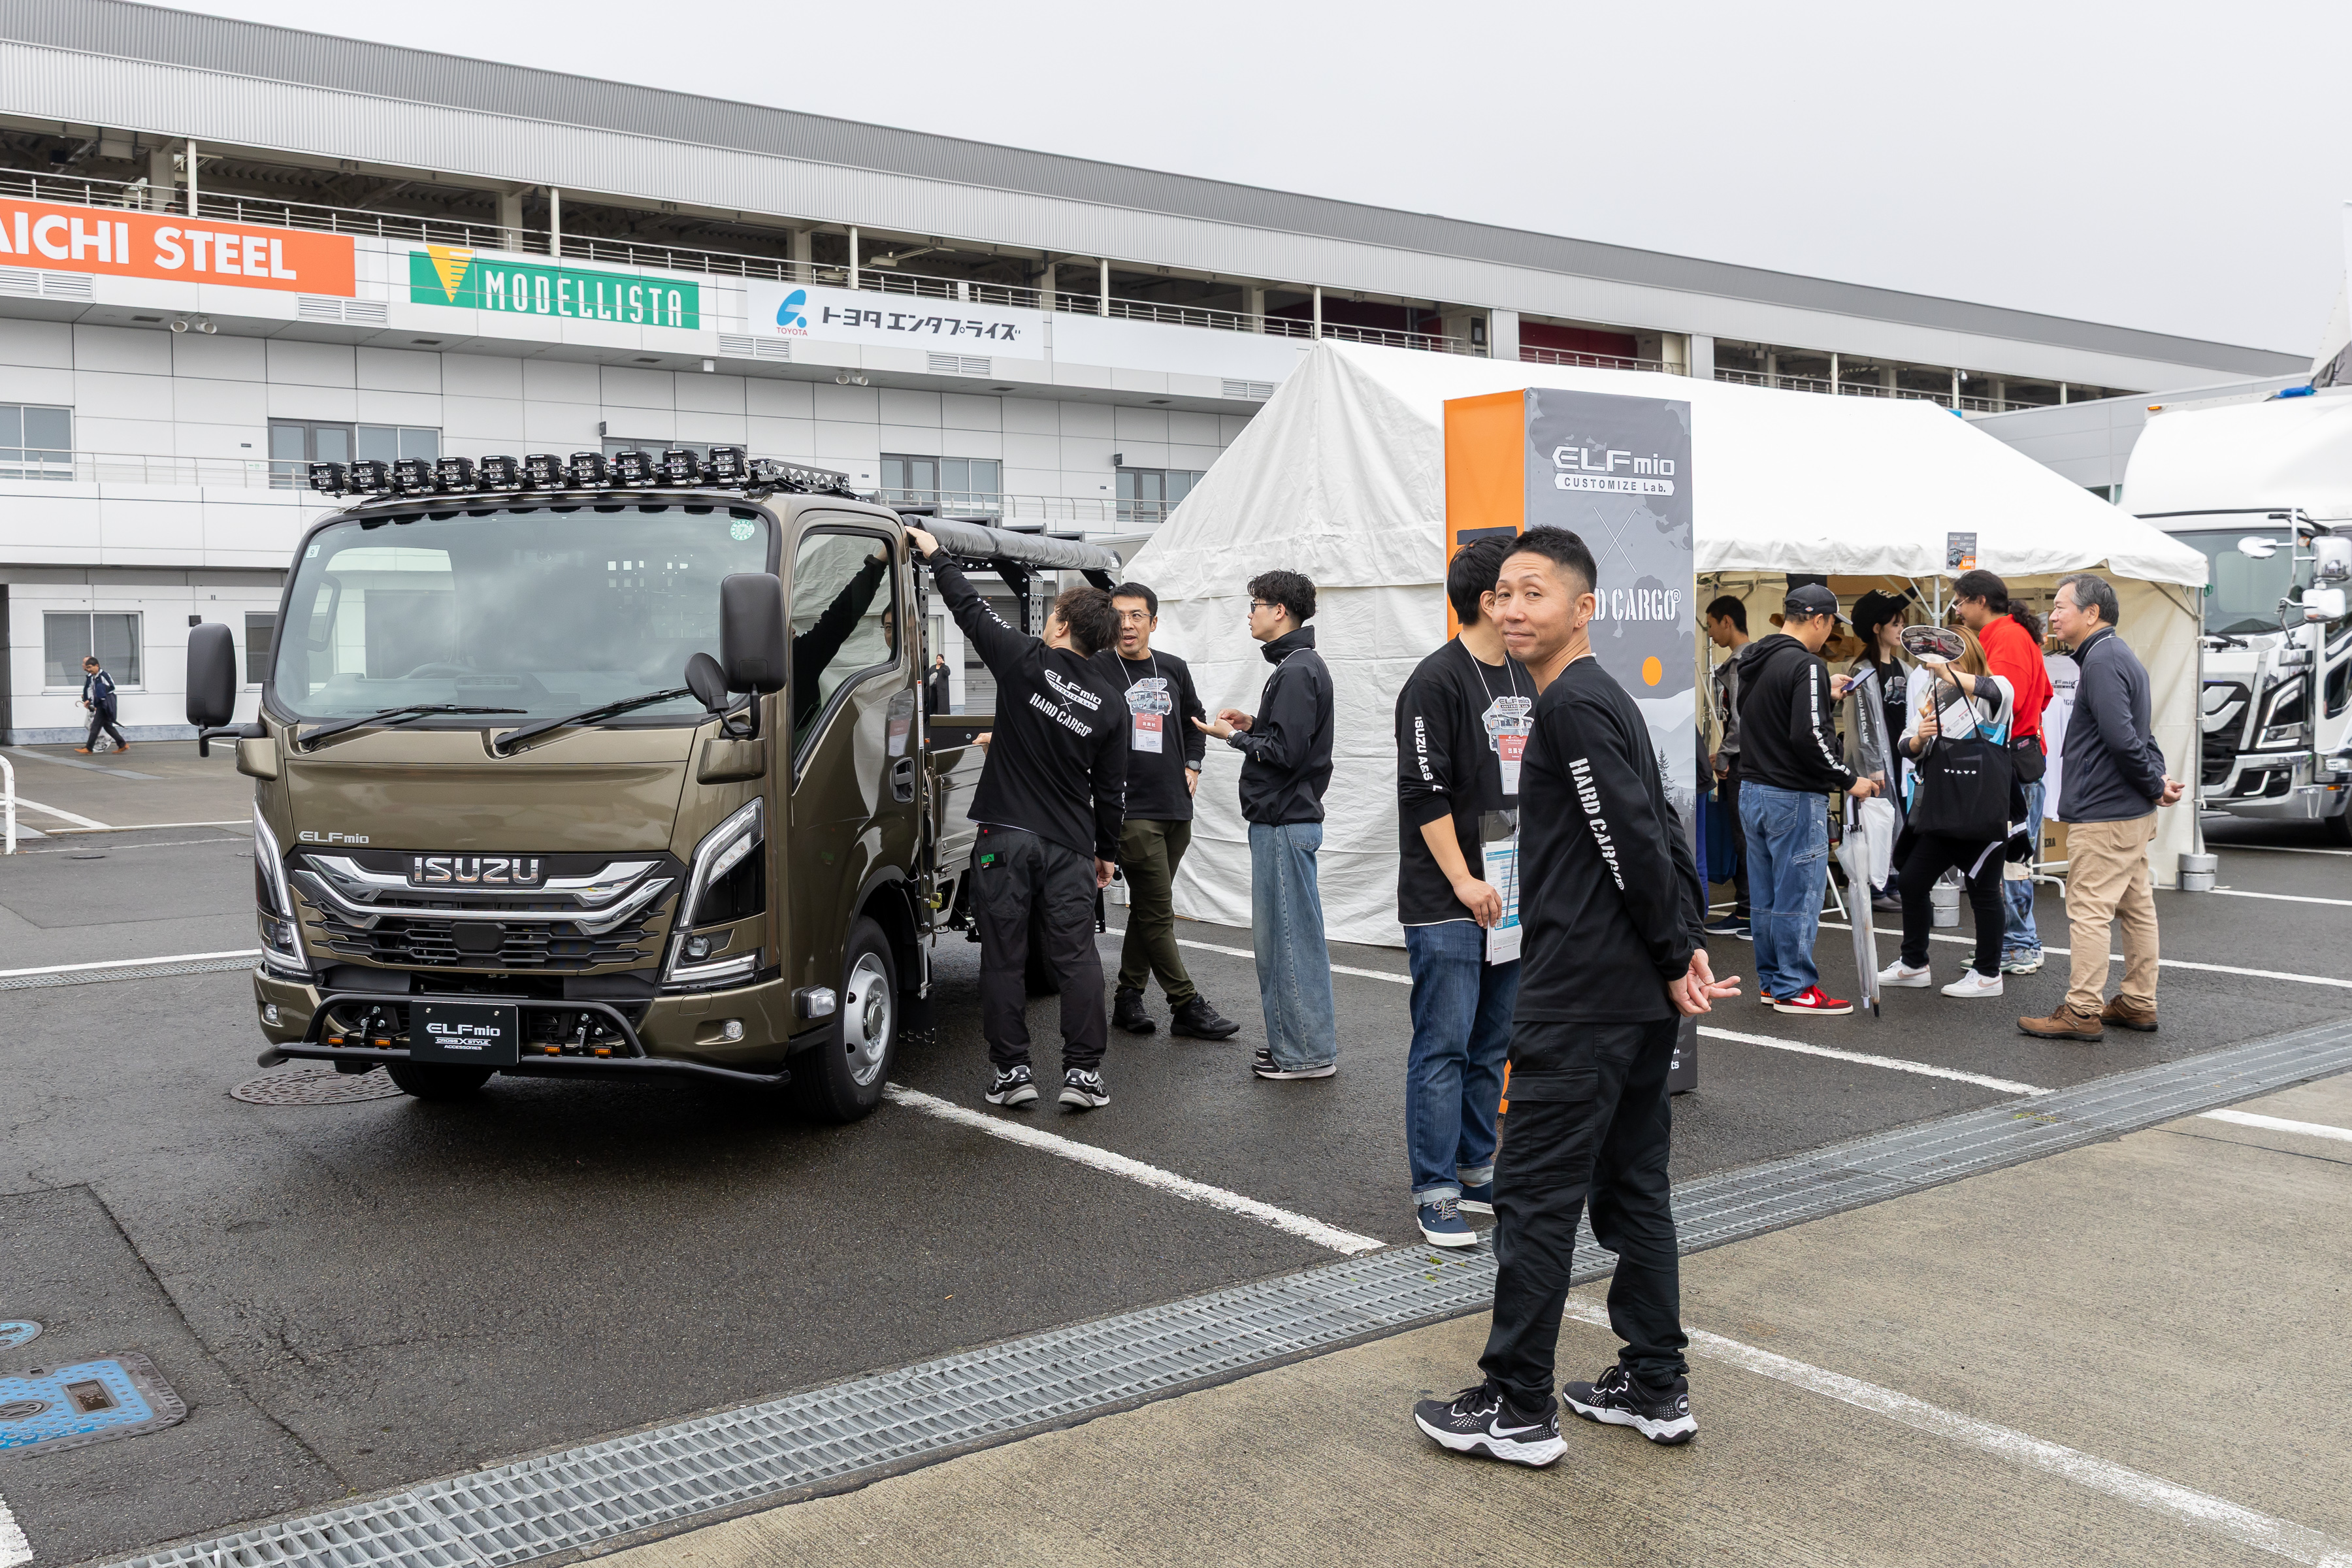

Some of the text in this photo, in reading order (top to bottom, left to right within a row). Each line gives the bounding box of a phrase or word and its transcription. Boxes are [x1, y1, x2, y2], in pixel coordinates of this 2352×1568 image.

[154, 226, 297, 281] STEEL
[485, 270, 682, 327] MODELLISTA
[776, 327, 808, 336] TOYOTA
[1552, 446, 1675, 476] ELFmio
[1564, 477, 1666, 493] CUSTOMIZE Lab.
[1044, 669, 1102, 705] ELFmio
[1050, 681, 1080, 702] USTOMIZE
[1029, 693, 1058, 717] HARD
[1414, 716, 1433, 781] ISUZU A&S
[1569, 757, 1601, 815] HARD
[299, 830, 370, 844] ELFmio
[414, 857, 540, 885] ISUZU
[426, 1022, 500, 1037] ELFmio
